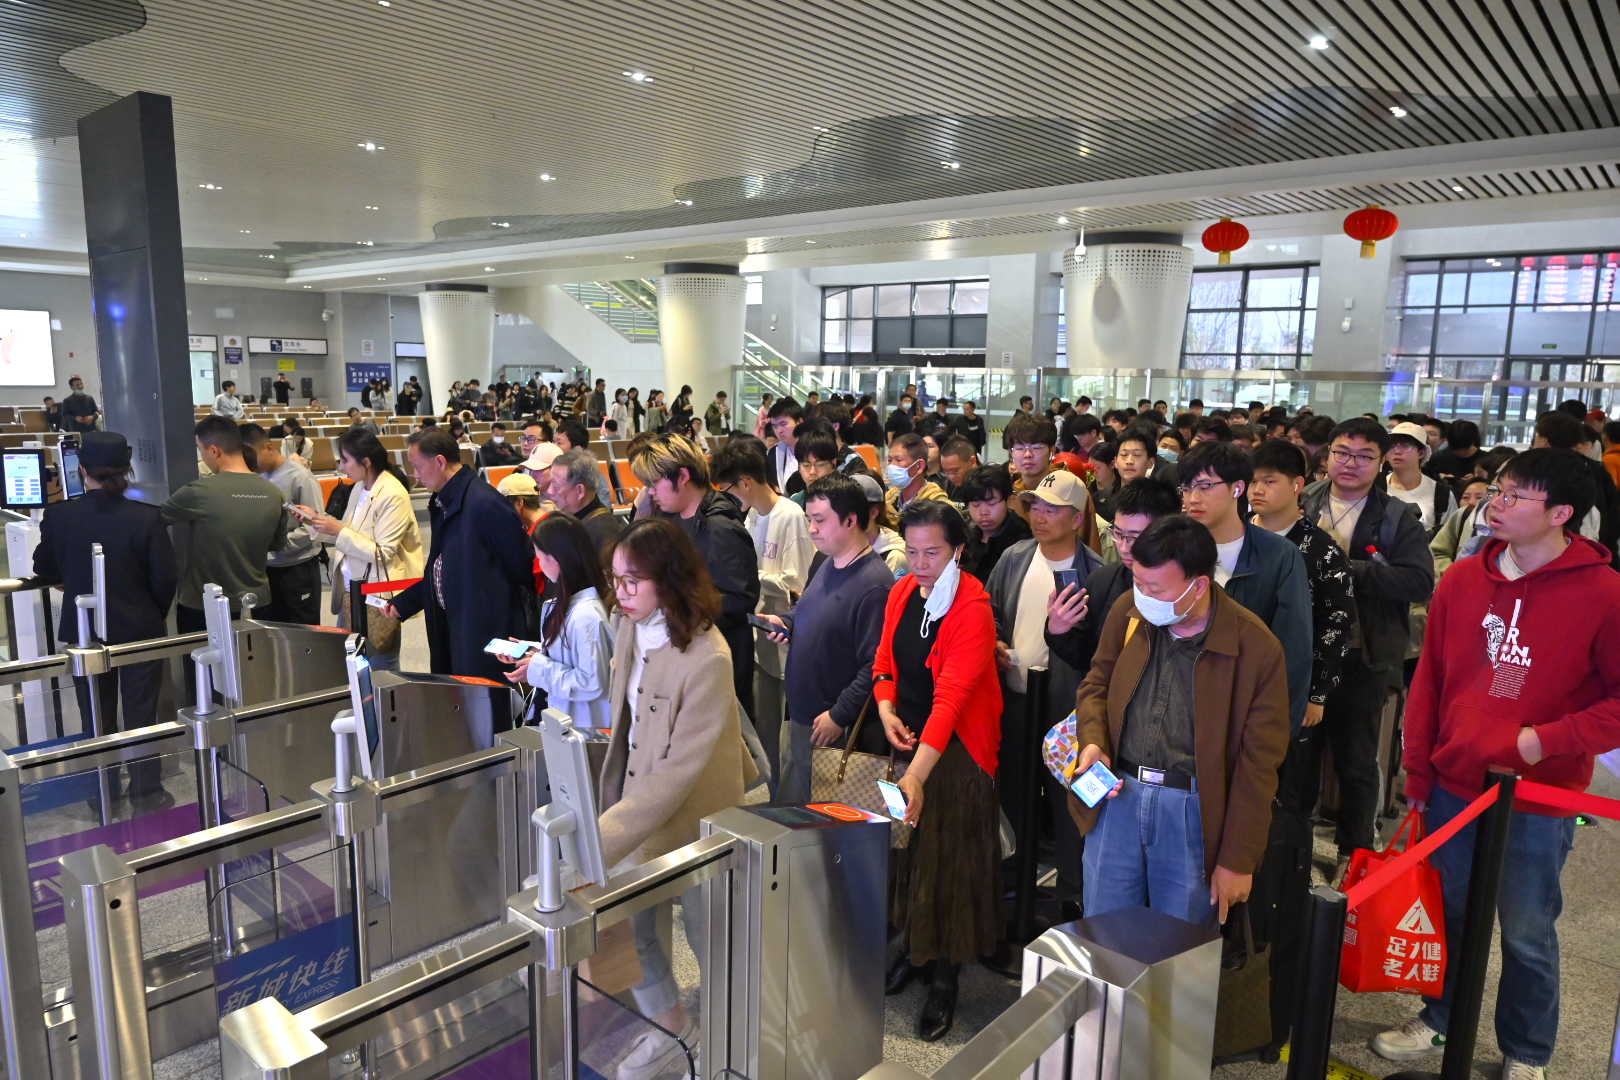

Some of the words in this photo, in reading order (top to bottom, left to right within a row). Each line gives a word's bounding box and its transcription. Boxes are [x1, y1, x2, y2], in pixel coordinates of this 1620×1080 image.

[1499, 652, 1532, 667] MAN
[1386, 936, 1442, 961] 足力健
[1382, 958, 1440, 982] 老人鞋
